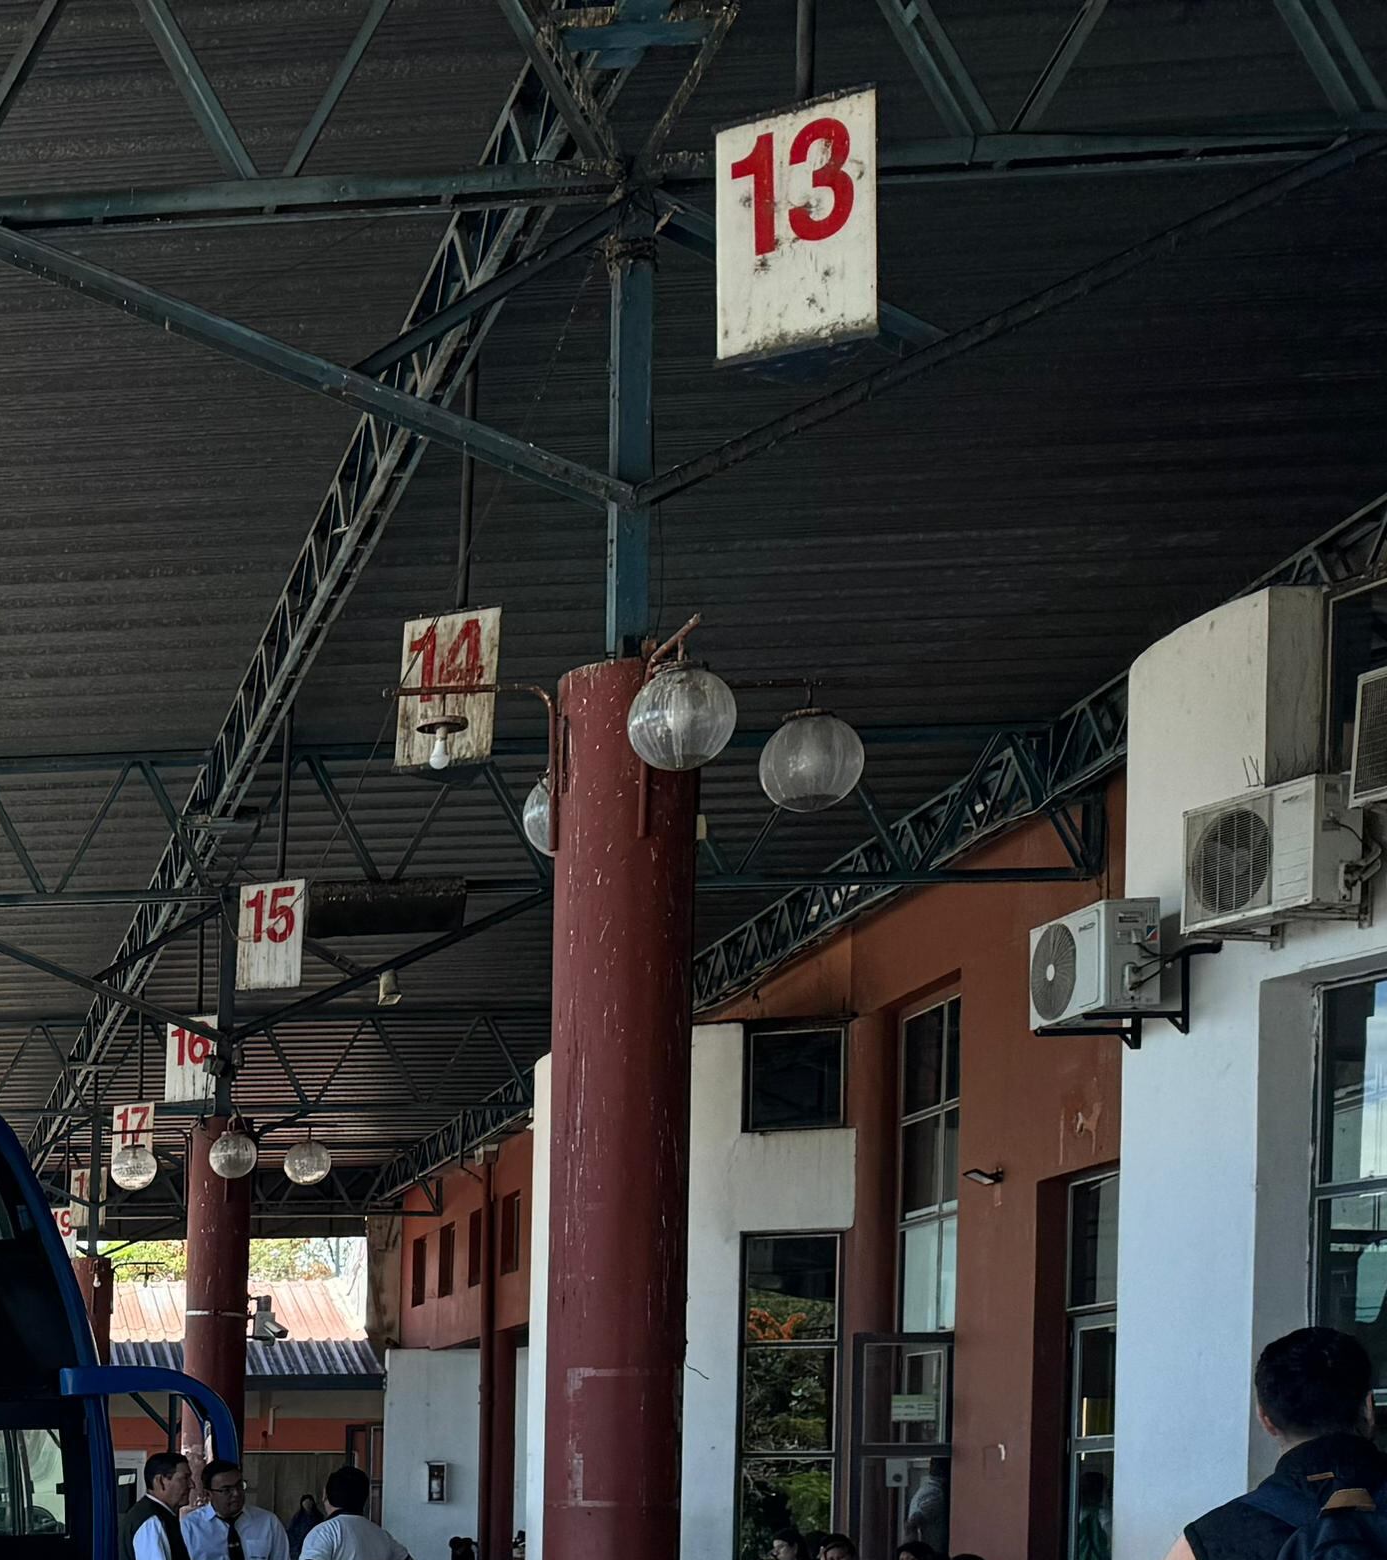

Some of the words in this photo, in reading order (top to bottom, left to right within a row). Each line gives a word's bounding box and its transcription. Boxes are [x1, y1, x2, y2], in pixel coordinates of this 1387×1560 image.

[731, 117, 855, 257] 13
[410, 618, 485, 703] 14
[245, 886, 296, 944] 15
[170, 1020, 213, 1067] 16
[116, 1105, 150, 1145] 17
